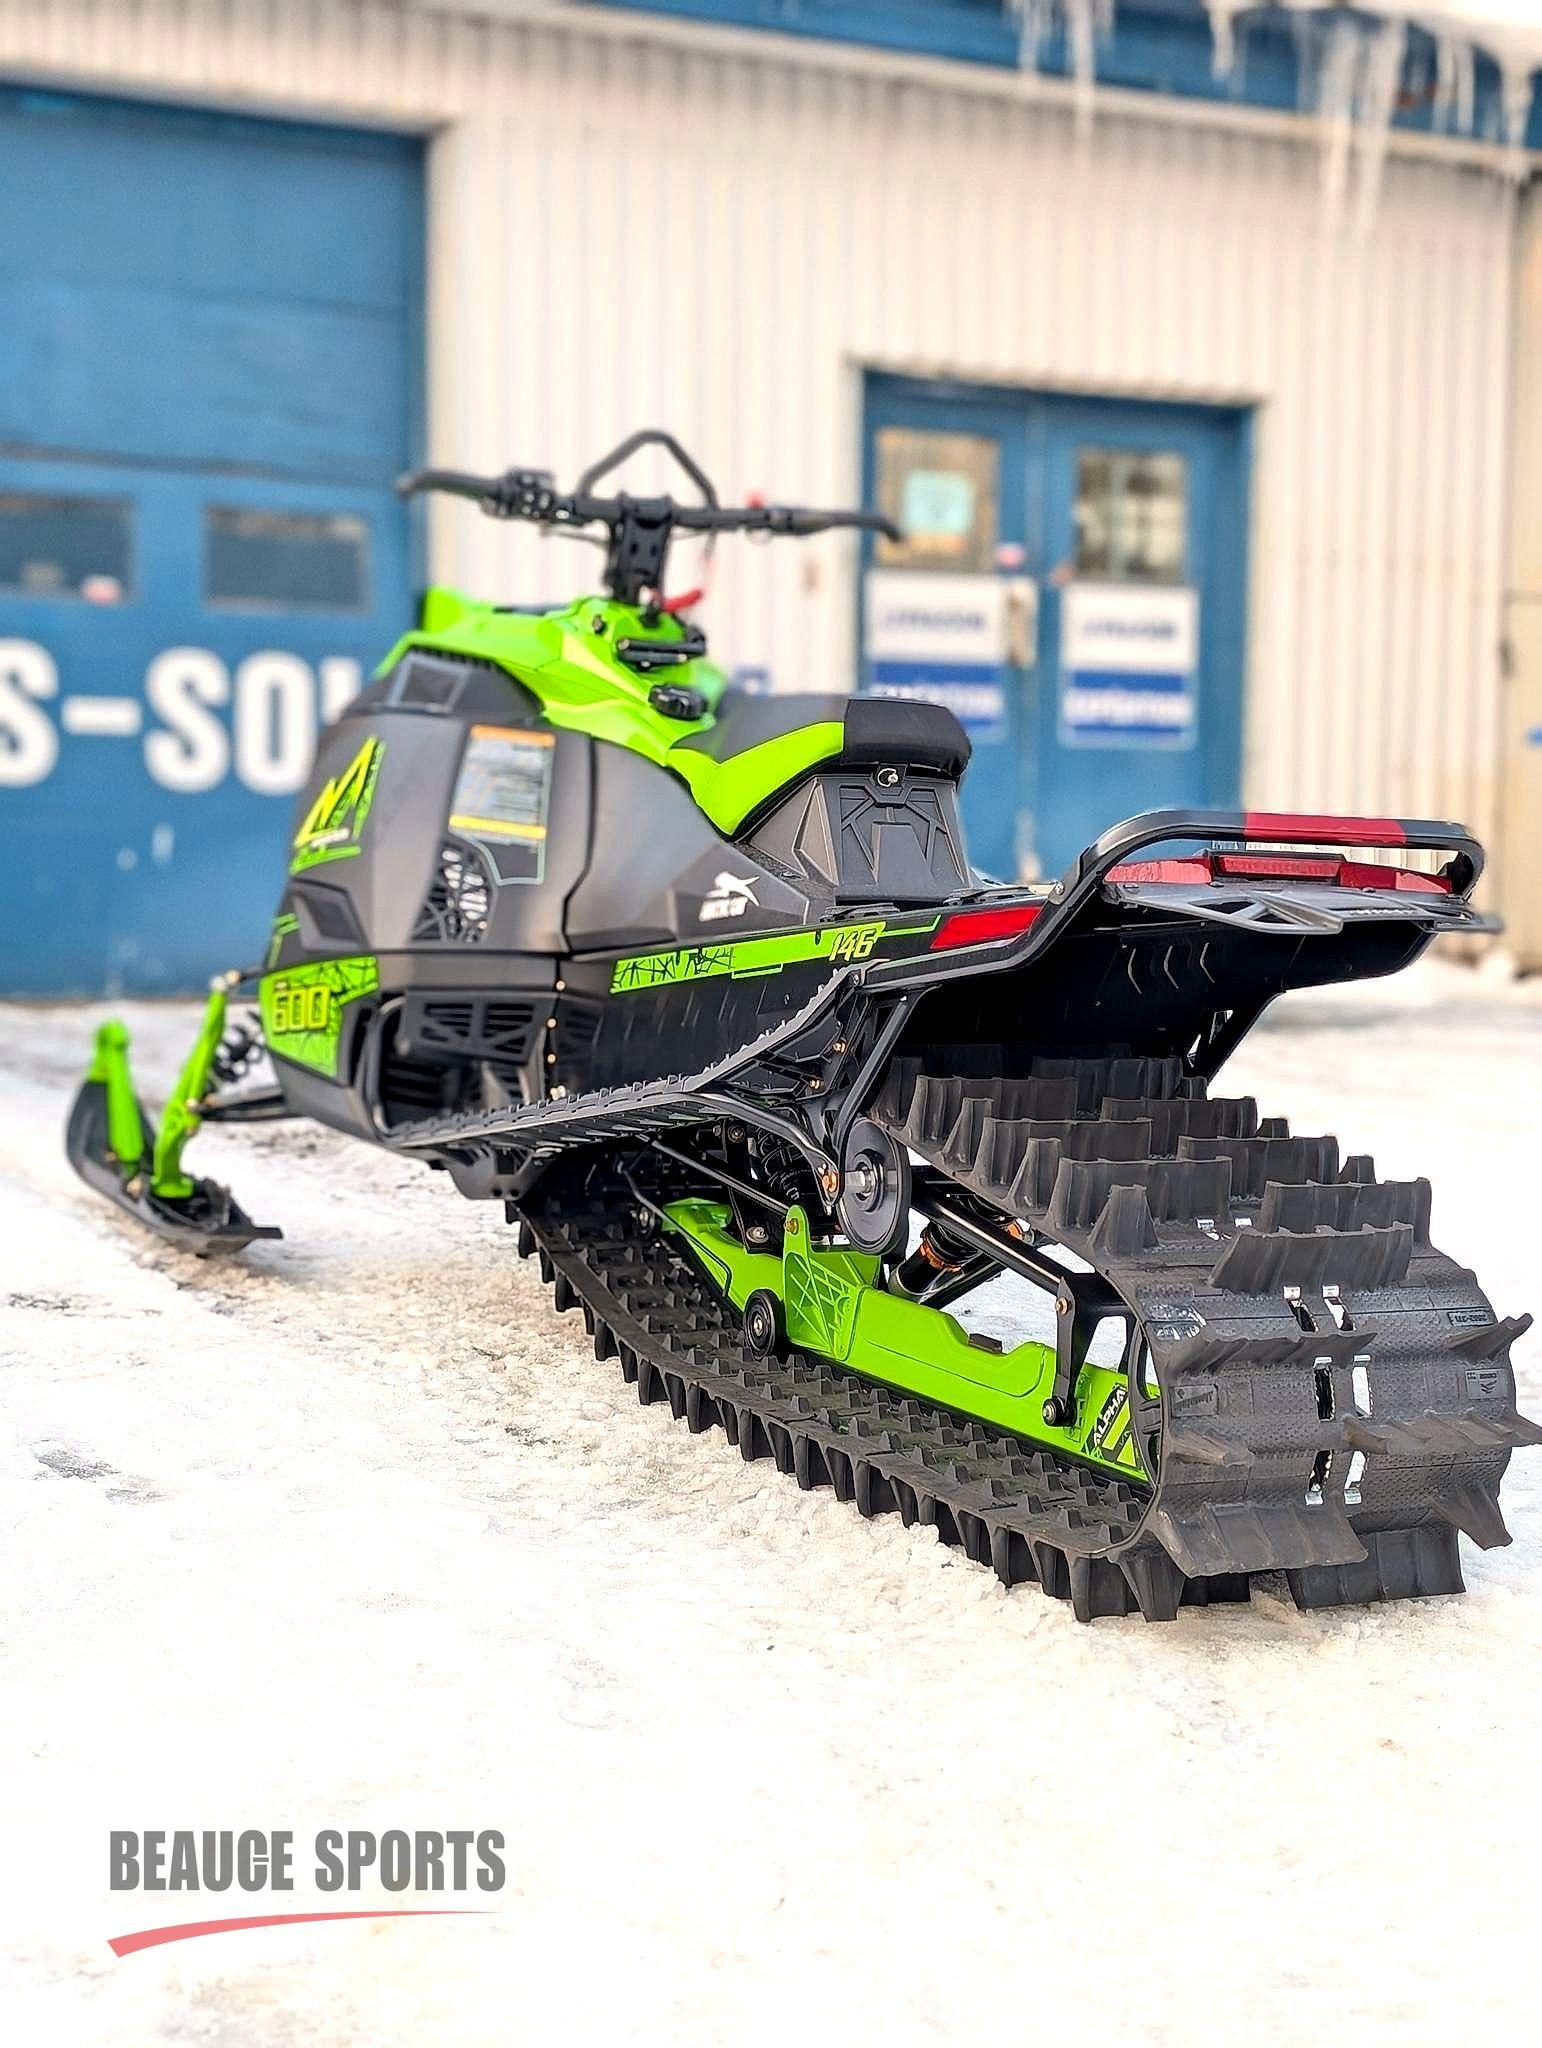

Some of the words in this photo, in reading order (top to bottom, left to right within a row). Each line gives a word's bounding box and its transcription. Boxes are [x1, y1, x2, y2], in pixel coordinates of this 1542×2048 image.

[828, 928, 877, 962] 146
[272, 985, 330, 1034] 600
[1092, 1386, 1127, 1447] ALPHA
